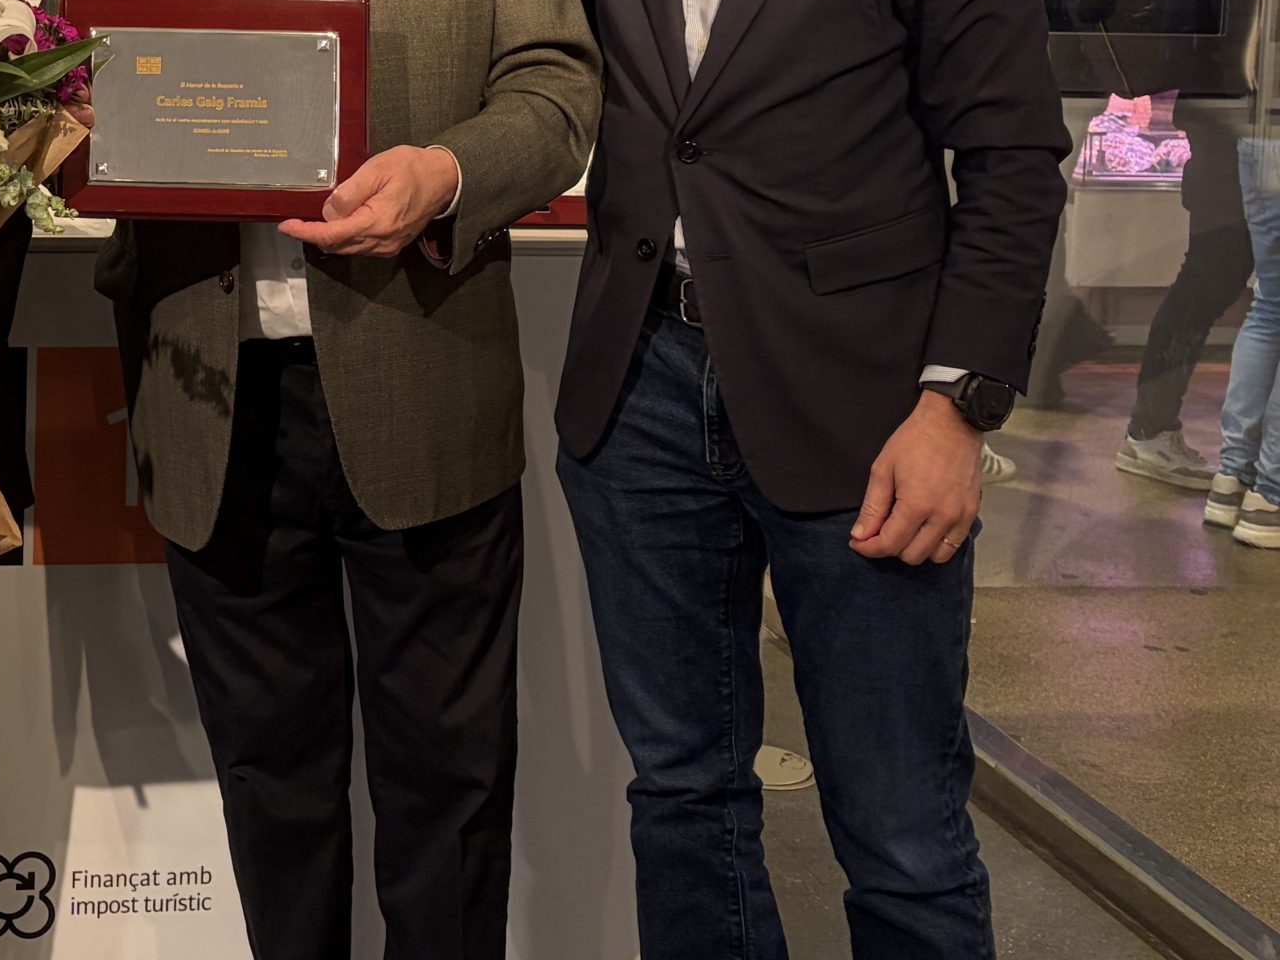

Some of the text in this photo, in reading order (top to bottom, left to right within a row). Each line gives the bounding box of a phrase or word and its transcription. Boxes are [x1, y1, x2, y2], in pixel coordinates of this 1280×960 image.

[156, 95, 193, 107] Carles
[196, 96, 224, 110] Gaig
[71, 865, 212, 892] Finançat amb
[70, 892, 212, 919] impost turístic
